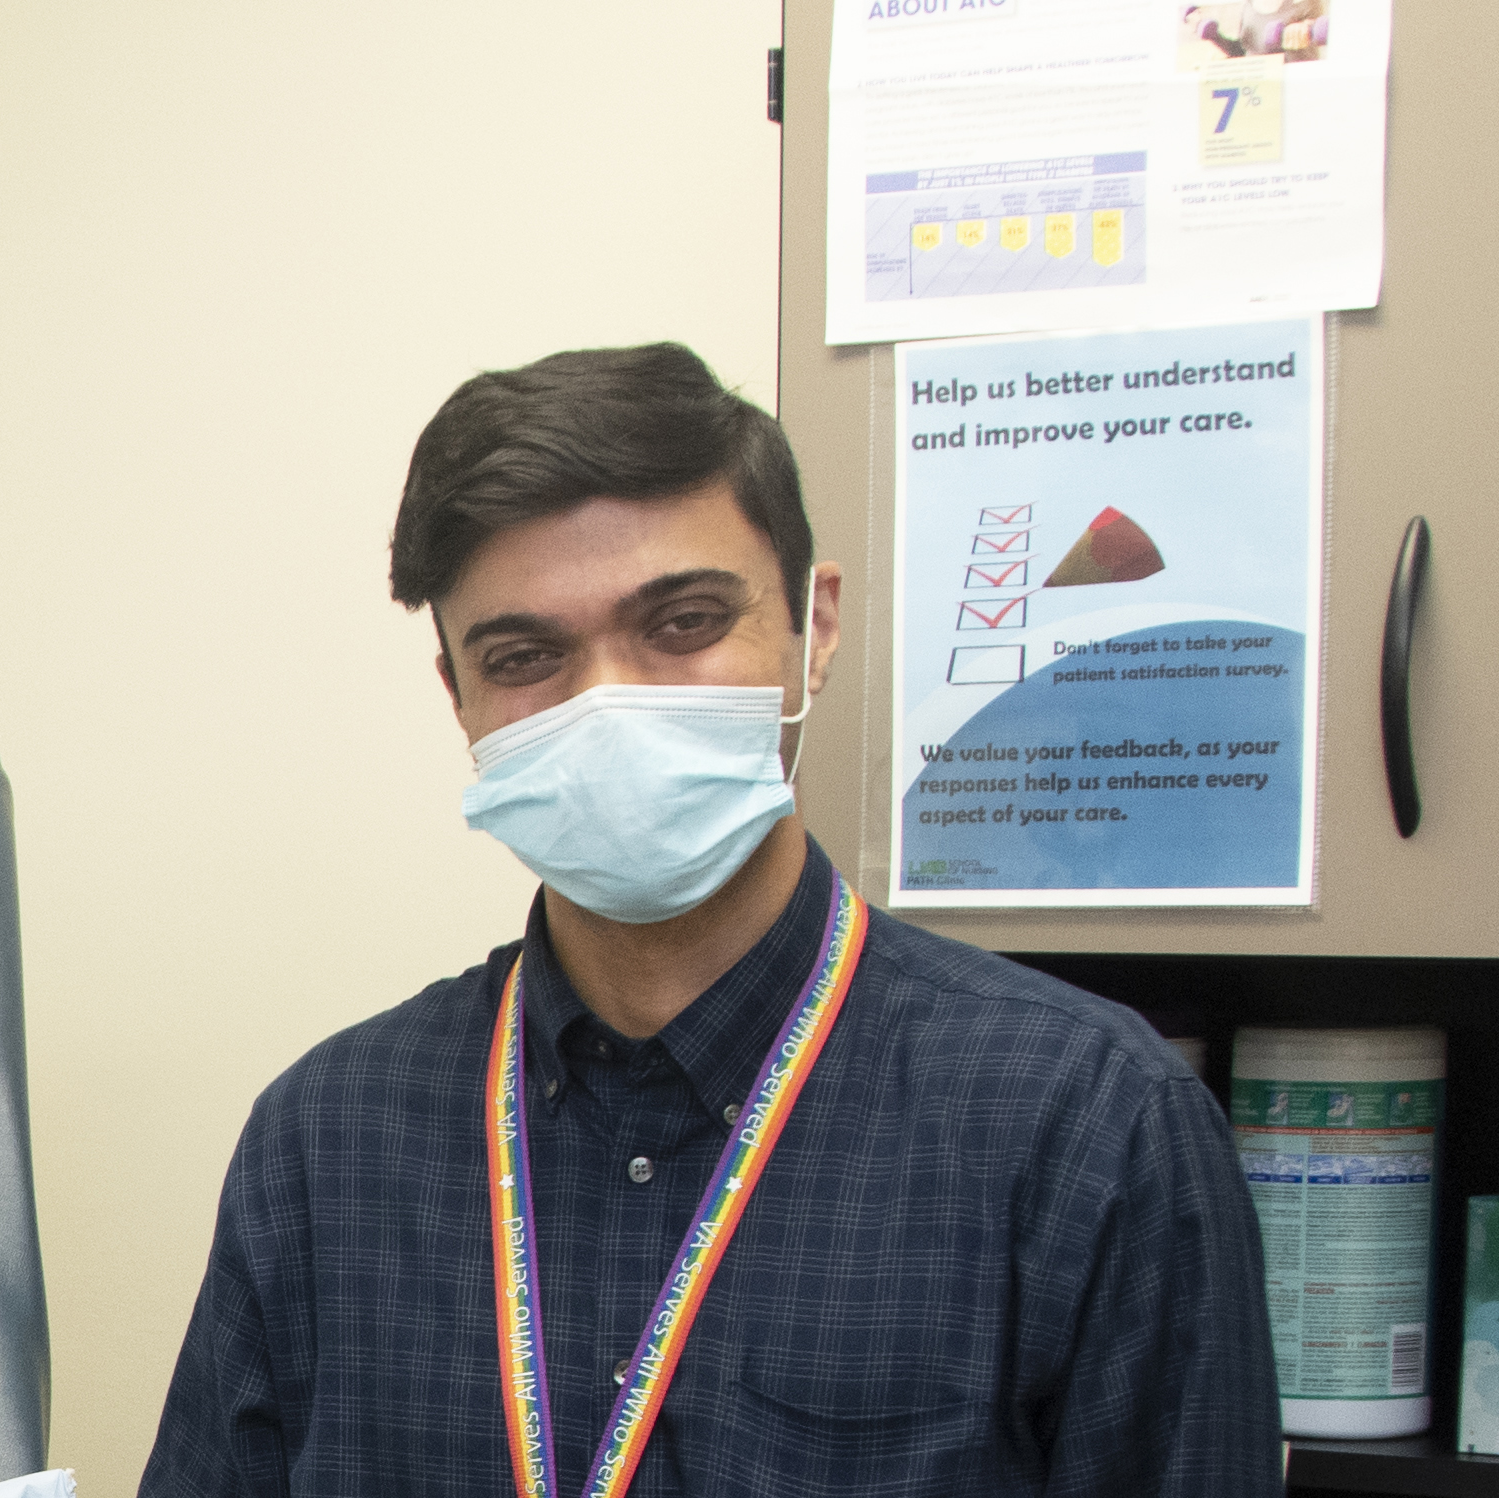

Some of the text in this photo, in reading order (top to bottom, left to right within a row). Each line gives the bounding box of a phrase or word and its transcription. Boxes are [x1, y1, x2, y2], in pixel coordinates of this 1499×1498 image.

[911, 352, 1296, 406] Help us better understand
[911, 410, 1253, 451] and improve your care.
[1053, 635, 1273, 656] Don't forget to take your
[1053, 662, 1289, 685] patient satisfaction survey.
[920, 738, 1280, 764] We value your feedback, as your
[919, 768, 1269, 796] responses help us enhance every
[919, 804, 1128, 826] aspect of your care.
[782, 1006, 823, 1059] Who
[739, 1063, 793, 1148] Served
[498, 1110, 517, 1146] VA
[690, 1220, 724, 1250] VA
[502, 1216, 530, 1299] Served
[654, 1256, 703, 1338] Serves
[509, 1306, 535, 1365] Who
[637, 1340, 665, 1381] All
[512, 1371, 538, 1402] All
[613, 1386, 653, 1444] Who
[525, 1411, 548, 1494] Serves
